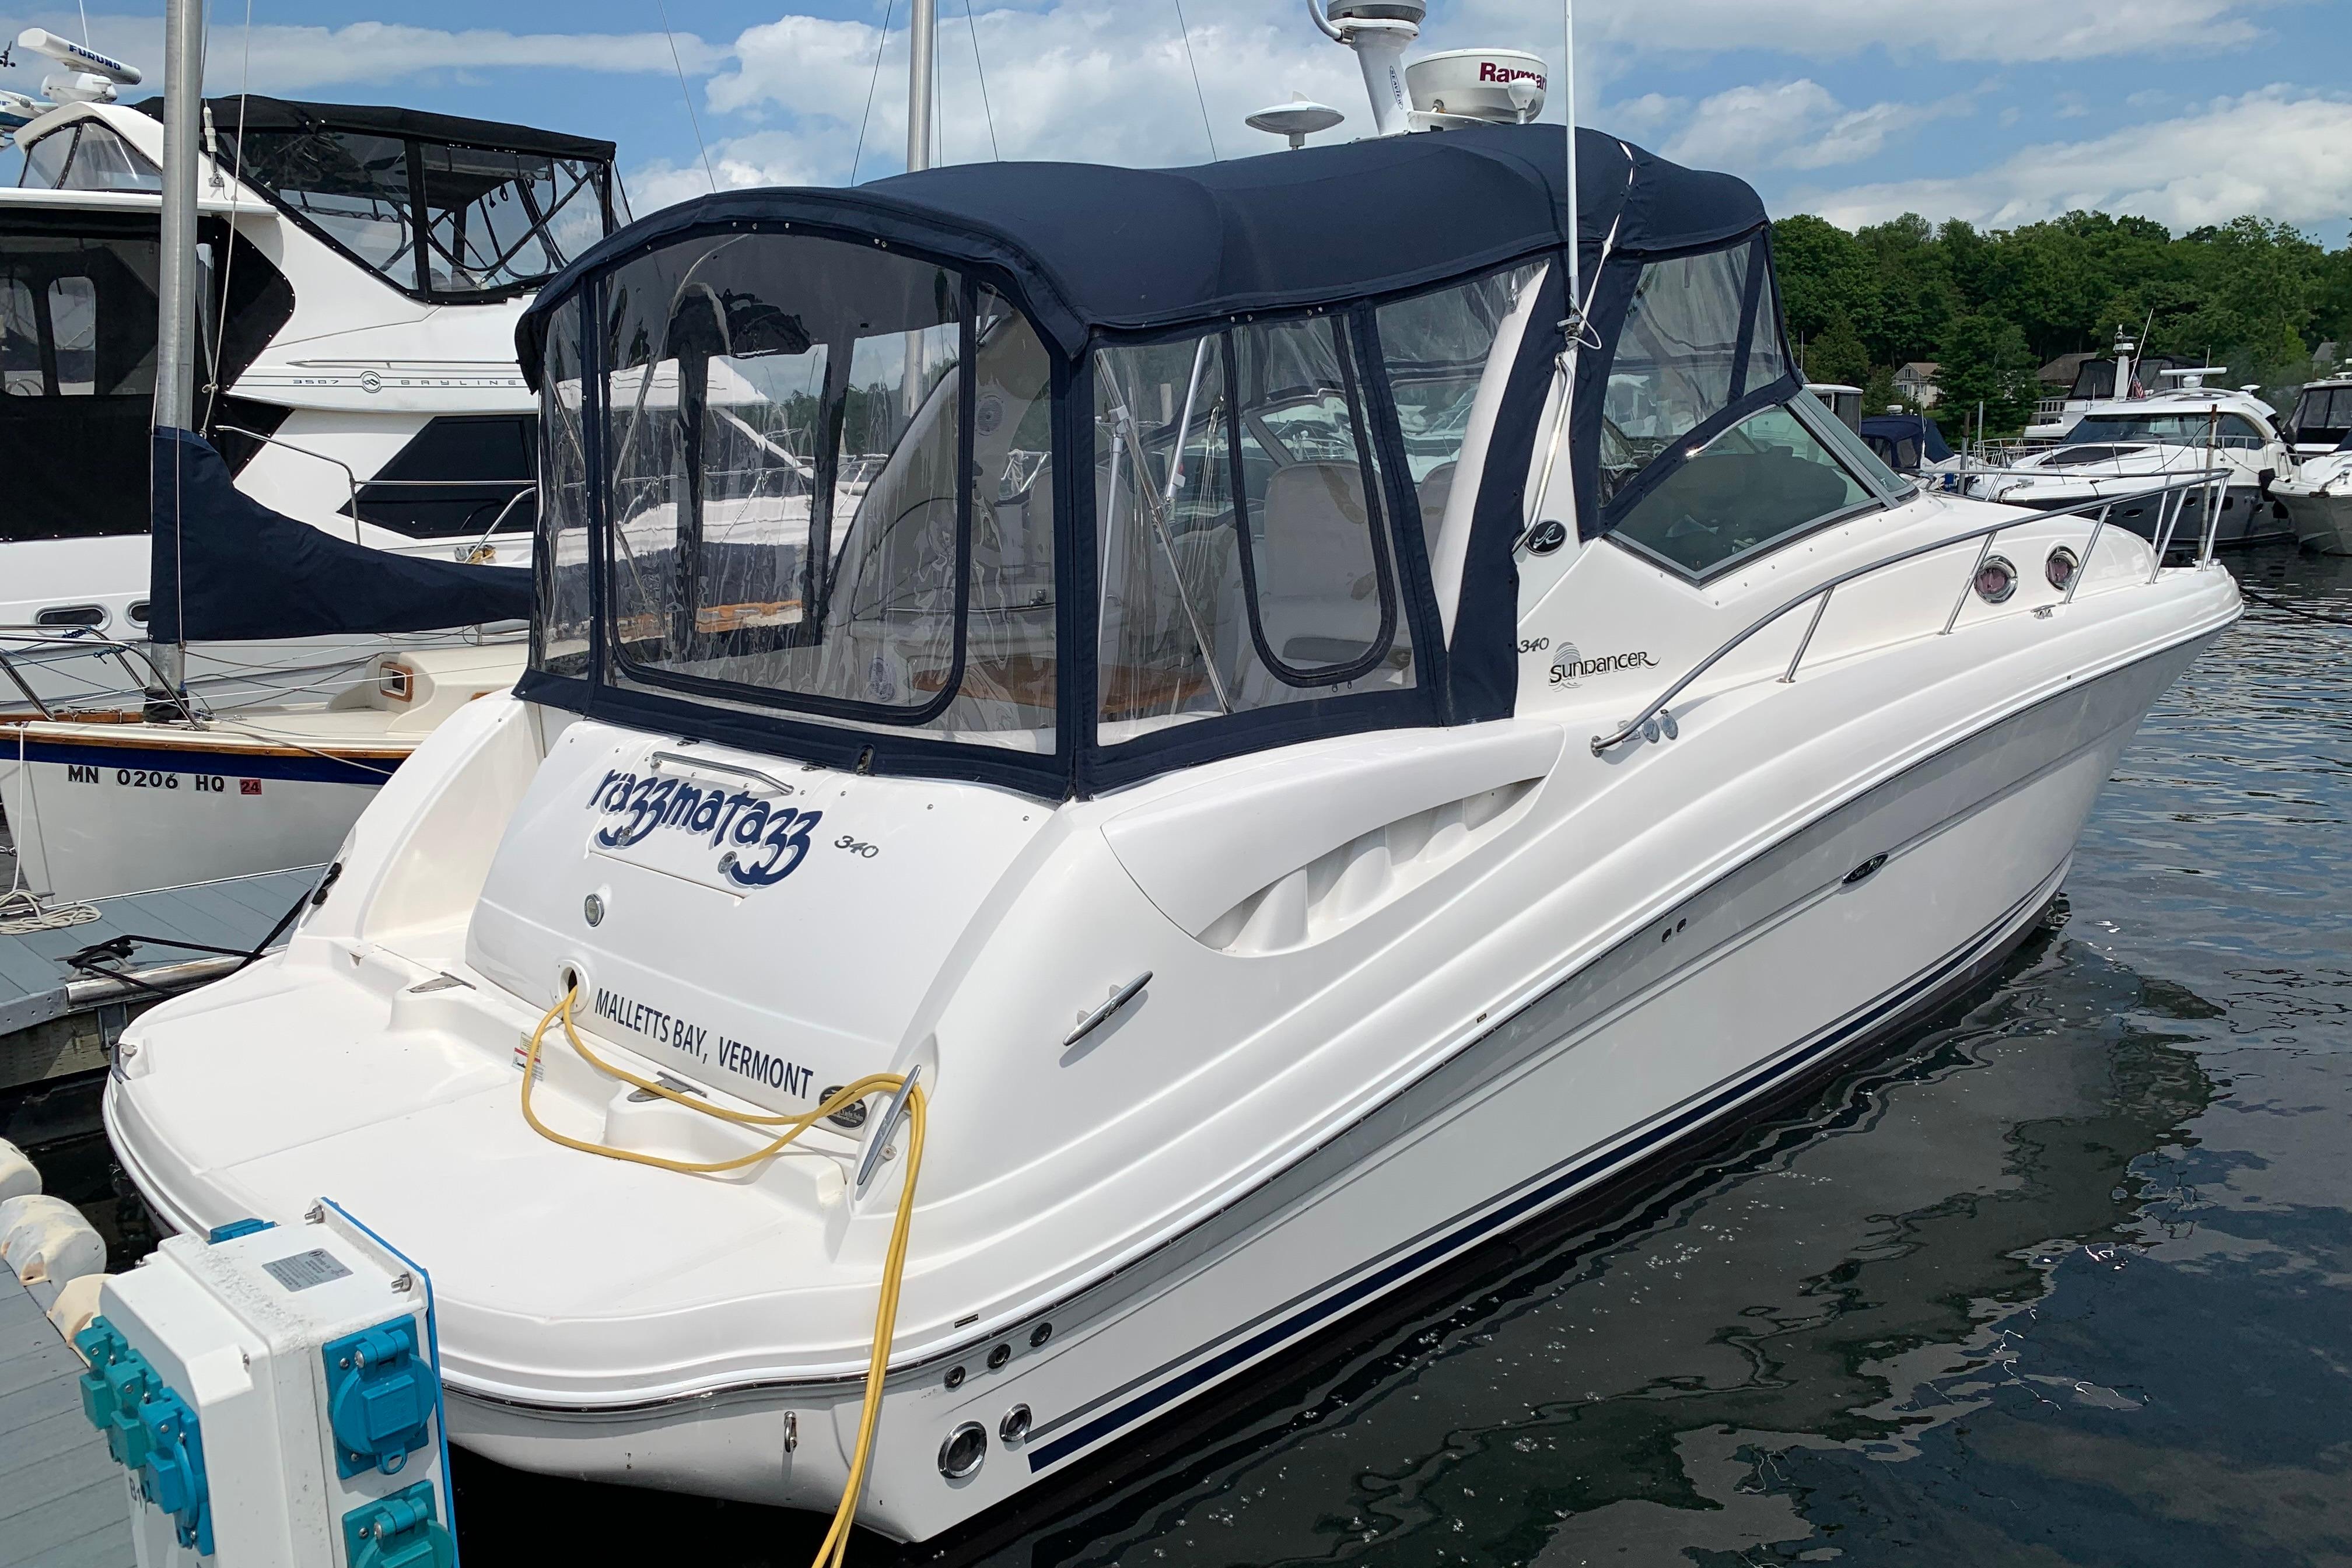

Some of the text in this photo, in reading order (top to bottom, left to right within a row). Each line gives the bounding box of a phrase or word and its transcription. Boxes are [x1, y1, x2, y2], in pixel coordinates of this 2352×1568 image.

[68, 44, 121, 71] FURUNO
[1517, 637, 1549, 654] 340
[68, 765, 225, 792] MN 0206 HQ
[241, 781, 260, 793] 24
[834, 835, 879, 858] 340
[594, 987, 814, 1100] MALLETTS BAY, VERMONT
